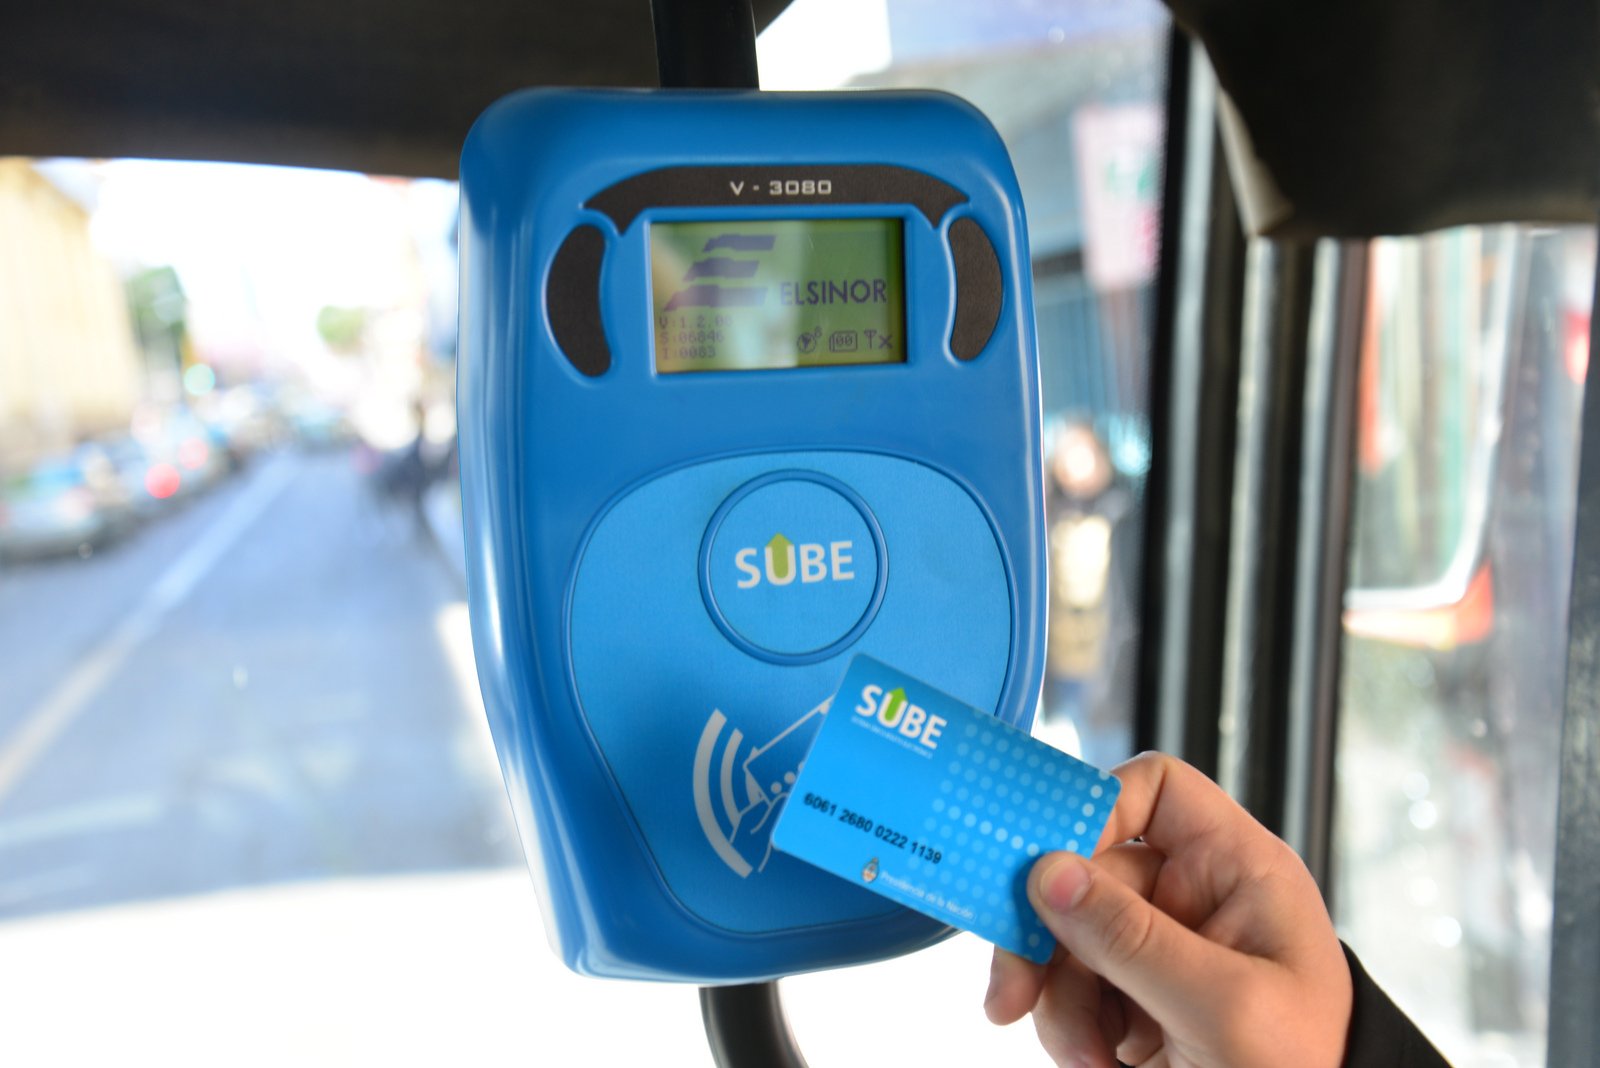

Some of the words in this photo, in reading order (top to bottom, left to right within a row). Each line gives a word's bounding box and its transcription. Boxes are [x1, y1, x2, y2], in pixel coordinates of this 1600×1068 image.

[730, 181, 744, 196] V
[769, 180, 832, 195] 3080
[780, 278, 888, 306] ELSINOR
[735, 532, 855, 589] SUBE
[855, 684, 948, 750] SUBE
[803, 792, 837, 816] 6061
[839, 809, 873, 833] 2680
[874, 825, 908, 849] 0222
[910, 841, 942, 864] 1139
